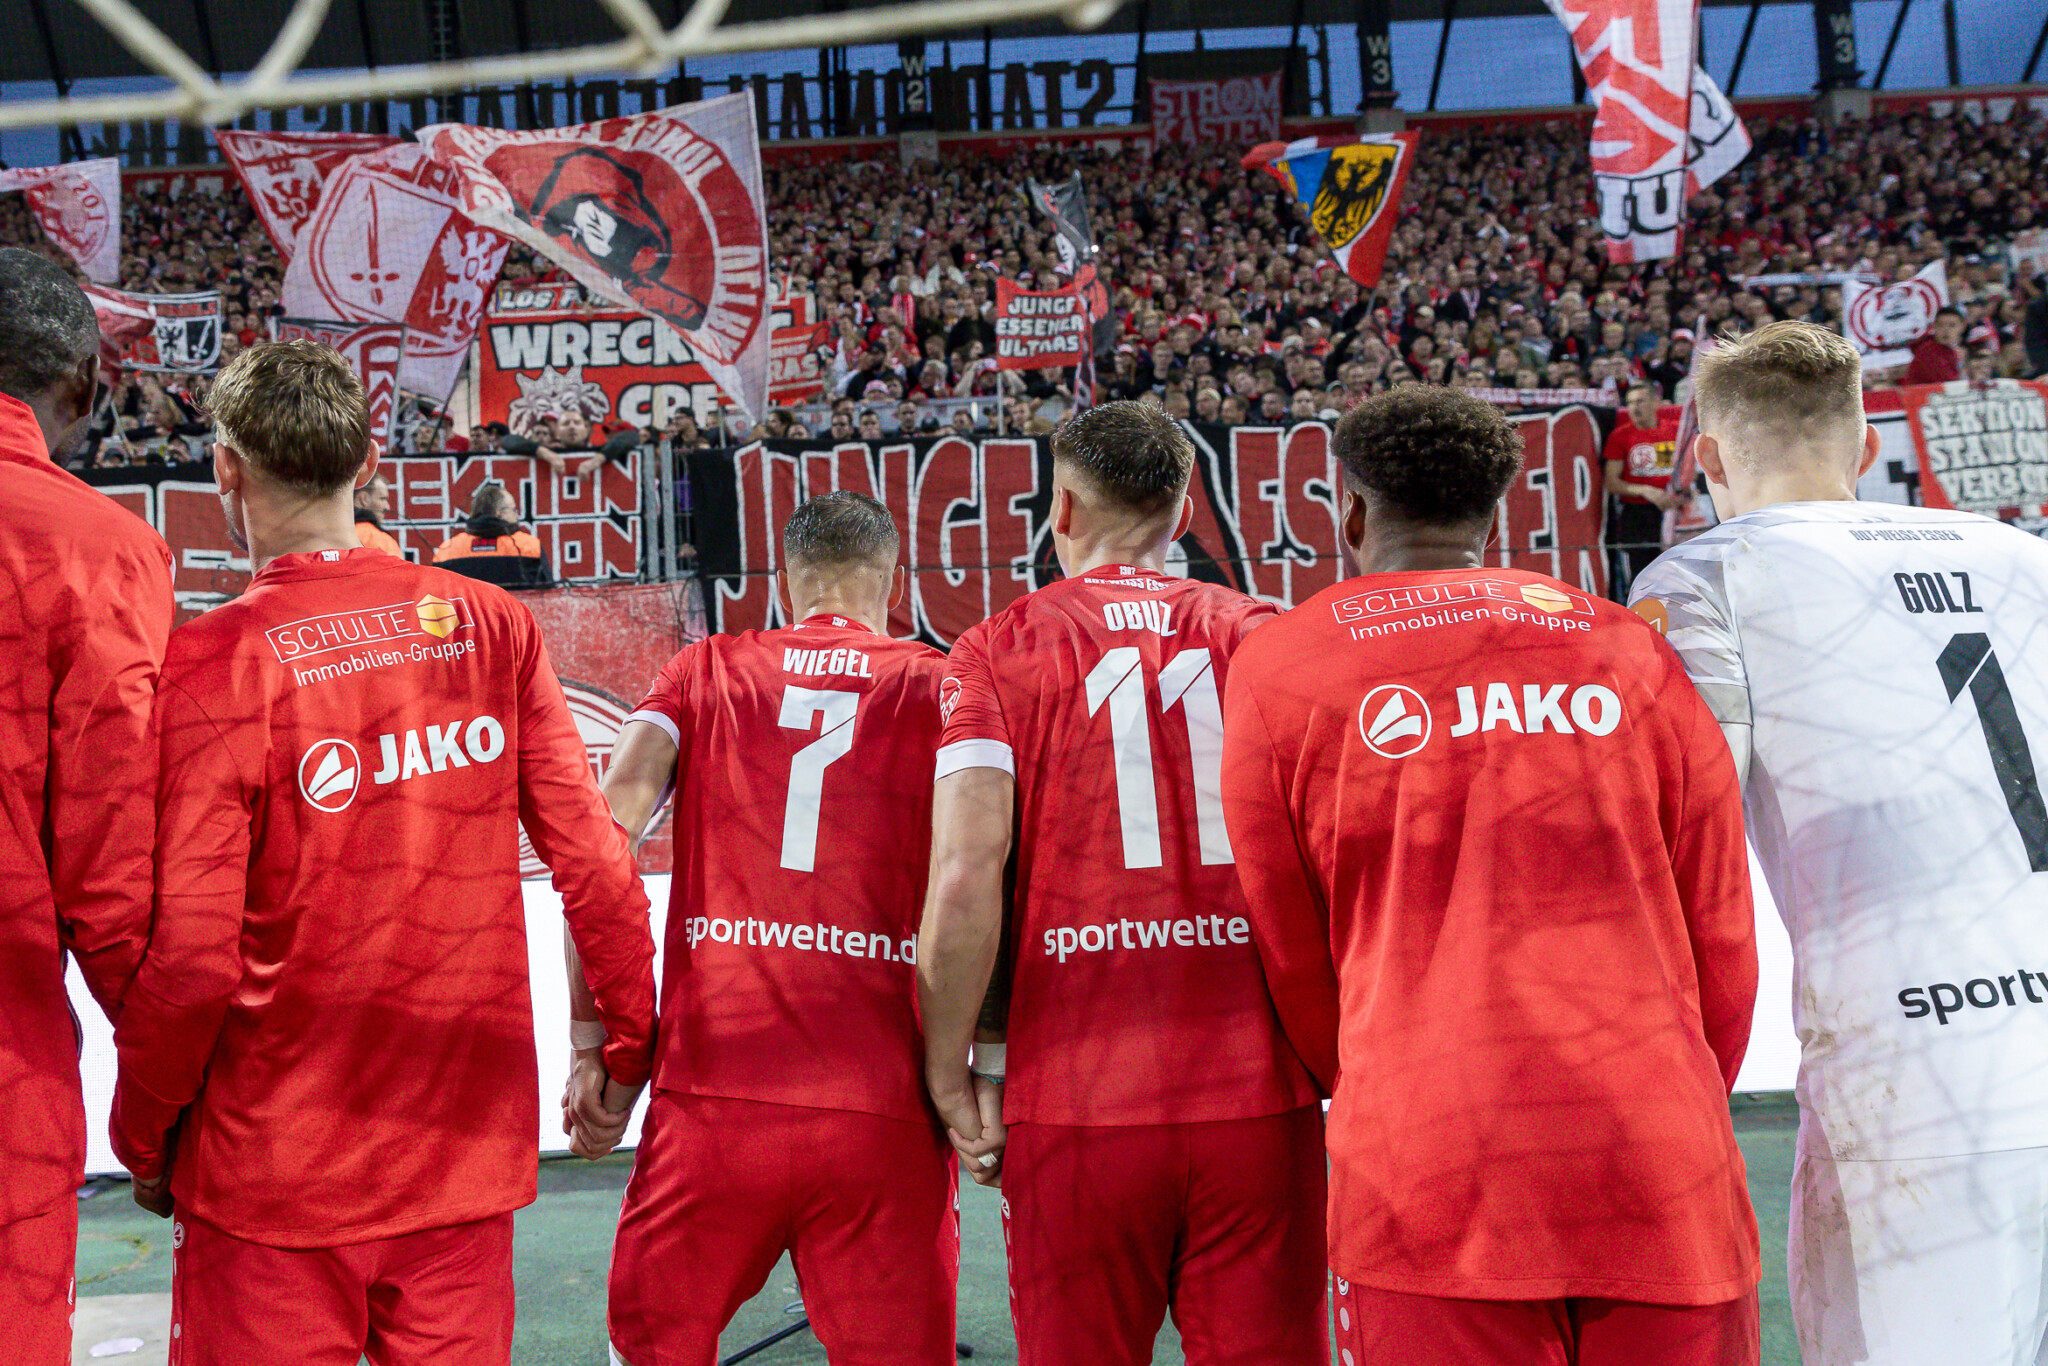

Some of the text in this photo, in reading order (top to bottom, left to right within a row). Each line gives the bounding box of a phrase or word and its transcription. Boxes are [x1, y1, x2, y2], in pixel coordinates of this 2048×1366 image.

[907, 79, 925, 106] 2
[1372, 59, 1391, 84] 3
[499, 288, 556, 310] LOS
[489, 317, 697, 370] WRECK
[995, 313, 1085, 336] ESSENER
[998, 334, 1080, 358] ULTRAS
[379, 451, 643, 522] EKTION
[1341, 580, 1507, 619] SCHULTE
[1893, 571, 1984, 614] GOLZ
[277, 609, 411, 656] SCHULTE
[1102, 599, 1178, 637] OBUZ
[1349, 605, 1592, 641] Immobilien-Gruppe
[293, 638, 476, 687] Immobilien-Gruppe
[782, 647, 873, 678] WIEGEL
[1450, 682, 1622, 738] JAKO
[373, 714, 506, 787] JAKO
[1085, 646, 1235, 870] 11
[1936, 632, 2048, 873] 1
[777, 684, 861, 872] 7
[685, 915, 917, 965] sportwetten.d
[1043, 914, 1250, 963] sportwette
